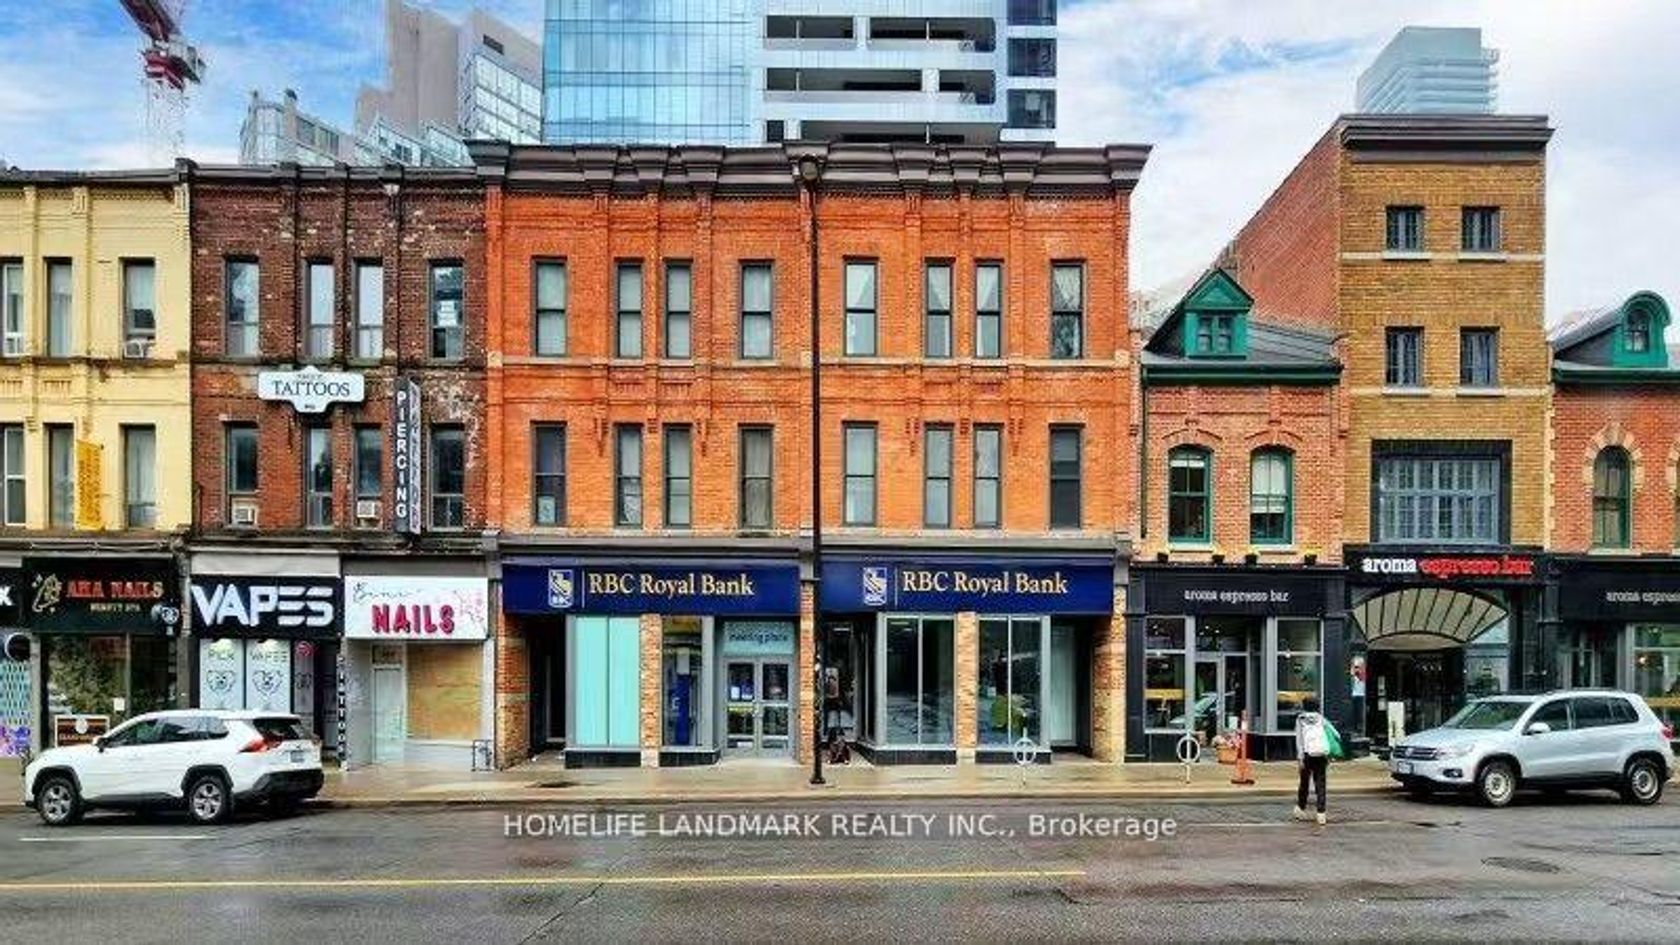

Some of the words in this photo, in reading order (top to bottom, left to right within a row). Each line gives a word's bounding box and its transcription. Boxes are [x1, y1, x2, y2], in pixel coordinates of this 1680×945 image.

[273, 380, 350, 396] TATTOOS
[396, 391, 407, 517] PIERCING
[1362, 557, 1417, 573] aroma
[588, 573, 634, 594] RBC
[640, 573, 695, 599] Royal
[702, 573, 755, 595] Bank
[903, 571, 949, 592] RBC
[954, 571, 1009, 597] Royal
[1016, 572, 1068, 594] Bank
[1184, 590, 1217, 600] aroma
[1220, 591, 1268, 604] espresso
[1270, 589, 1289, 601] bar
[1606, 592, 1640, 602] aroma
[191, 583, 334, 627] VAPES
[371, 604, 455, 634] NAILS
